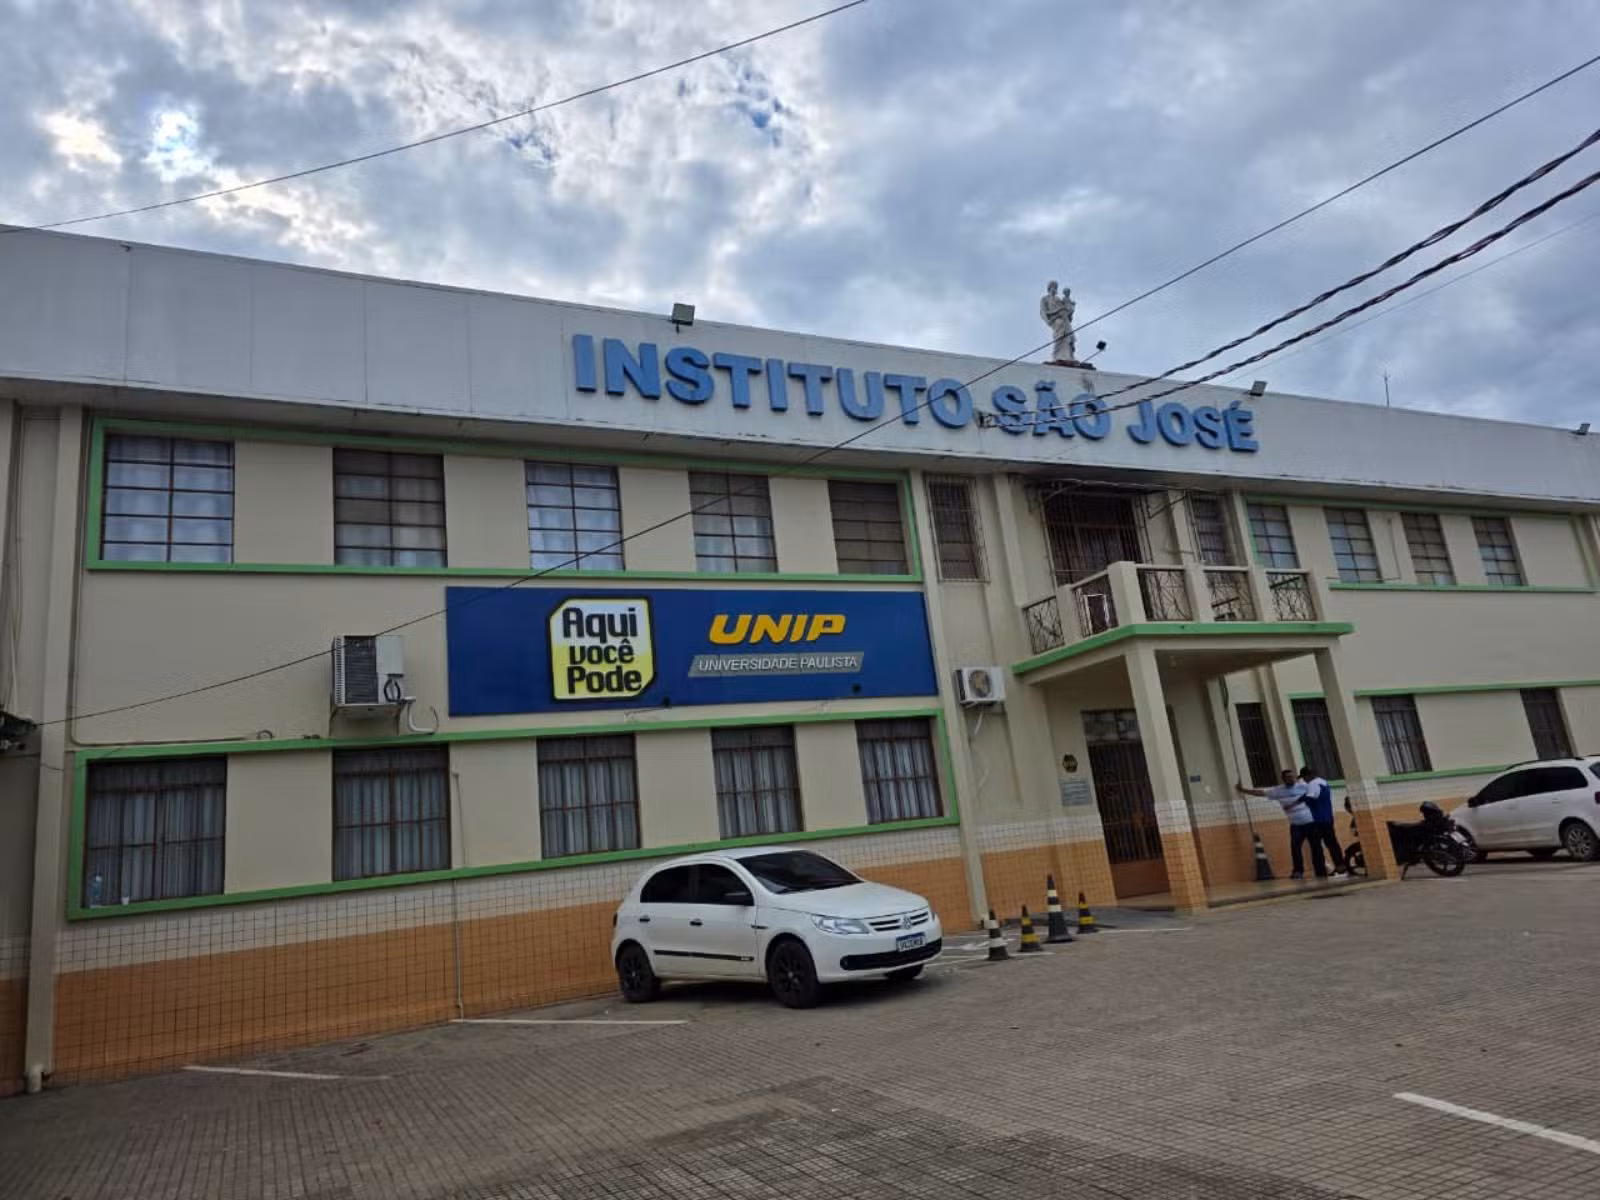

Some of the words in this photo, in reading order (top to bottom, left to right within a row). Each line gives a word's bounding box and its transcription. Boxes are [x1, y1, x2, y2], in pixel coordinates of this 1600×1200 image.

[572, 334, 973, 429] INSTITUTO
[992, 380, 1112, 440] SÃO
[1127, 400, 1259, 452] JOSÉ
[562, 607, 638, 643] Aqui
[708, 614, 846, 645] UNIP
[569, 638, 634, 666] você
[698, 658, 797, 673] UNIVERSIDADE
[800, 655, 858, 671] PAULISTA
[567, 665, 642, 694] Pode
